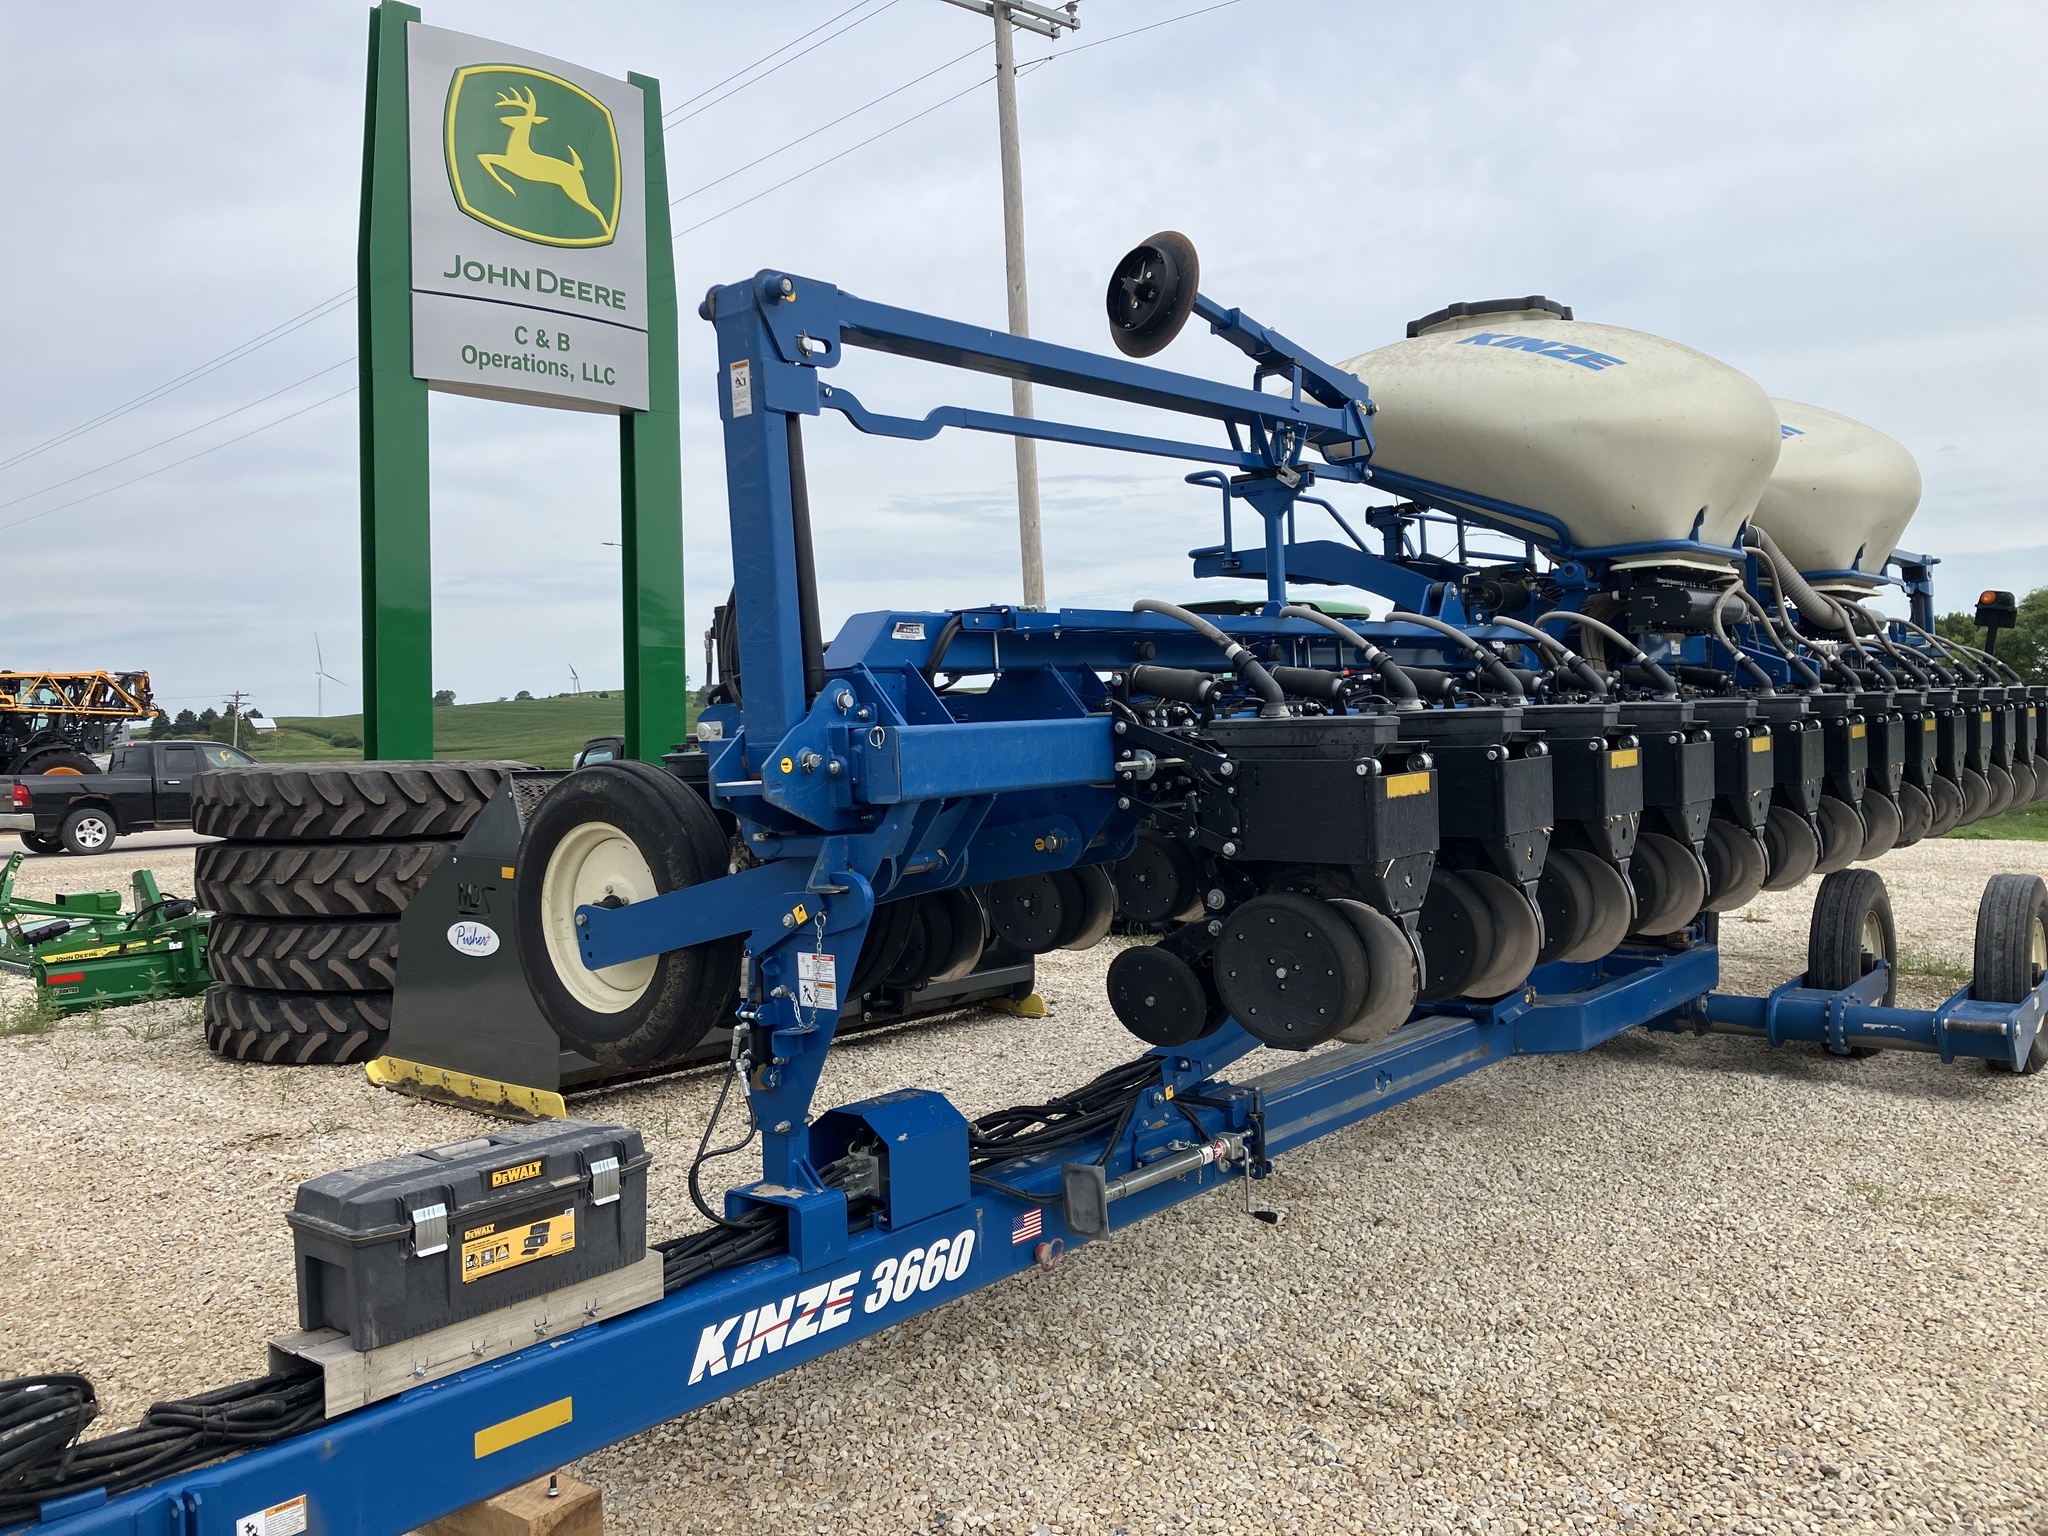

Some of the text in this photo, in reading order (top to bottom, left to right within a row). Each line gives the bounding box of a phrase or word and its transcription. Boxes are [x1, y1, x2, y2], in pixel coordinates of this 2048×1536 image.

[443, 254, 627, 310] JOHN DEERE
[514, 326, 571, 352] C & B
[1457, 333, 1627, 371] KINZE
[461, 345, 616, 386] Operations, LLC
[688, 1229, 975, 1386] KINZE 3660
